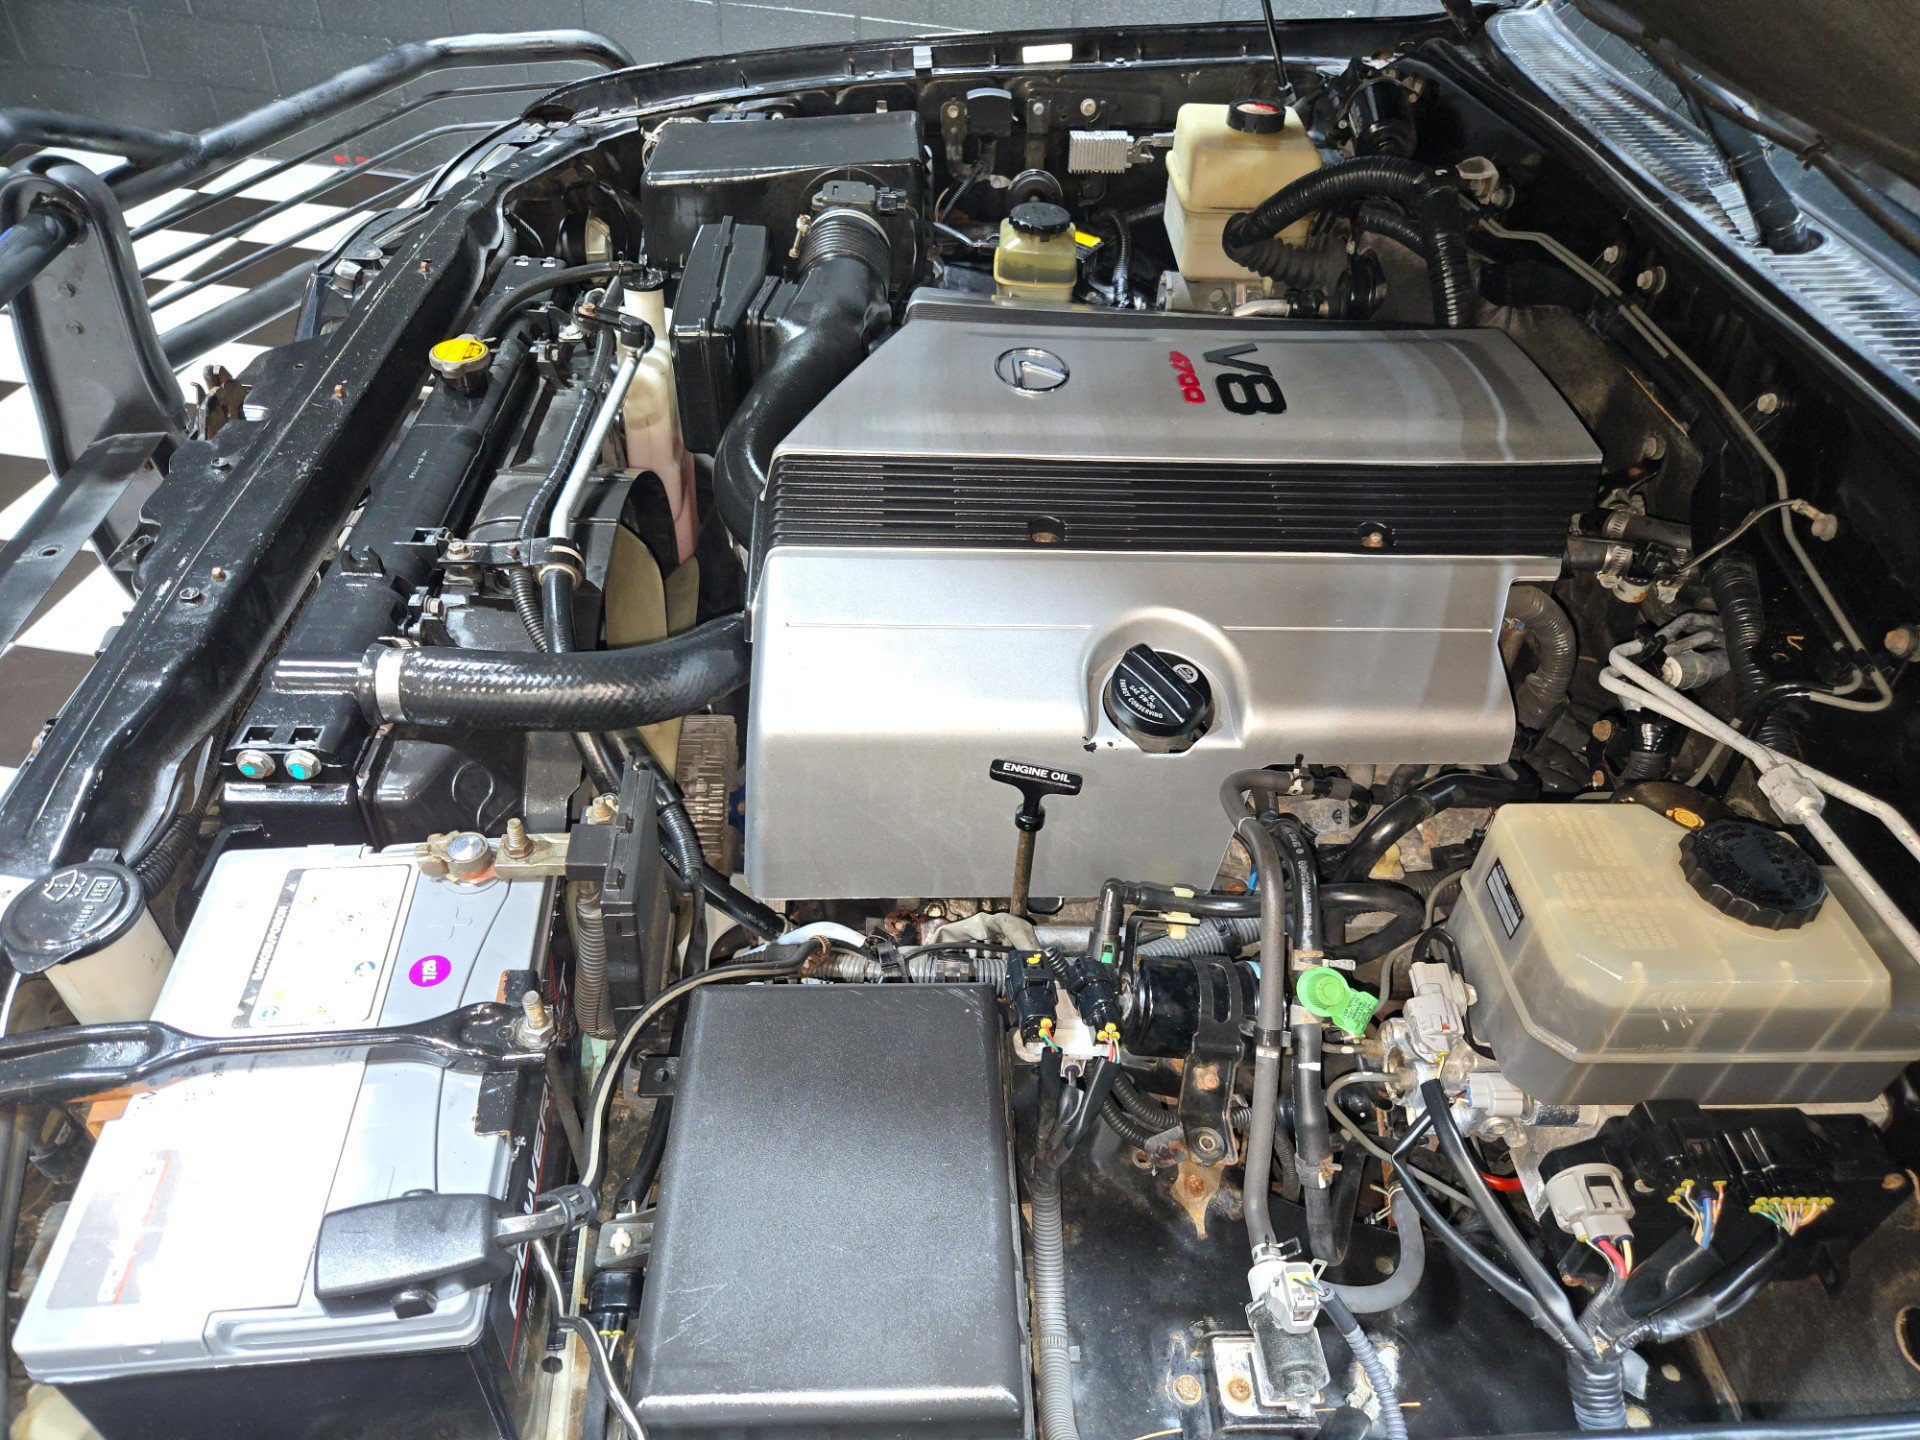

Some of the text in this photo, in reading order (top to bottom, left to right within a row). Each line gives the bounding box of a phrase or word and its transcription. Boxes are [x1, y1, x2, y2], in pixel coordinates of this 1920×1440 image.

[1168, 350, 1206, 404] 4700
[1202, 342, 1287, 415] V8
[1129, 685, 1140, 695] SAE
[1128, 698, 1164, 719] CONSERVING
[1002, 762, 1071, 783] ENGINE OIL
